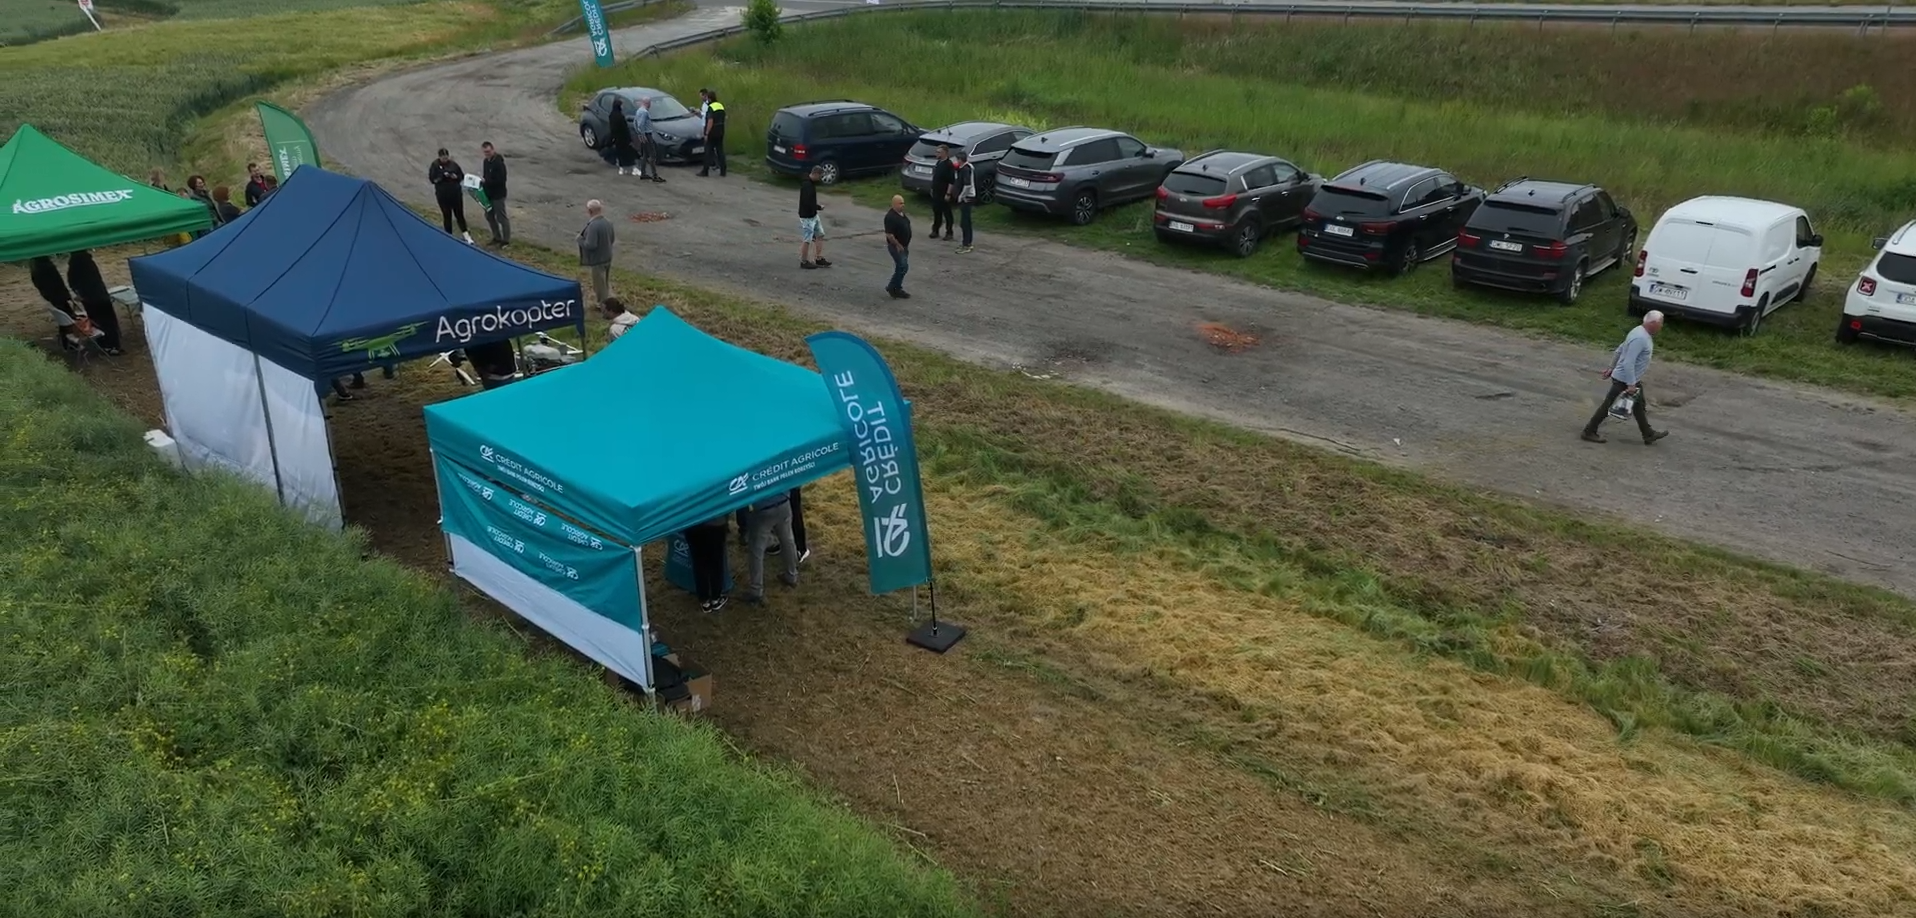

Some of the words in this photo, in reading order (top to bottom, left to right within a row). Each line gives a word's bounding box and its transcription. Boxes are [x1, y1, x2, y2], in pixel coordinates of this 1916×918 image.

[12, 189, 133, 214] AGROSIMEX
[435, 299, 576, 343] Agrokopter
[752, 460, 790, 481] CRÉDIT
[791, 442, 840, 467] AGRICOLE
[523, 467, 564, 494] AGRICOLE
